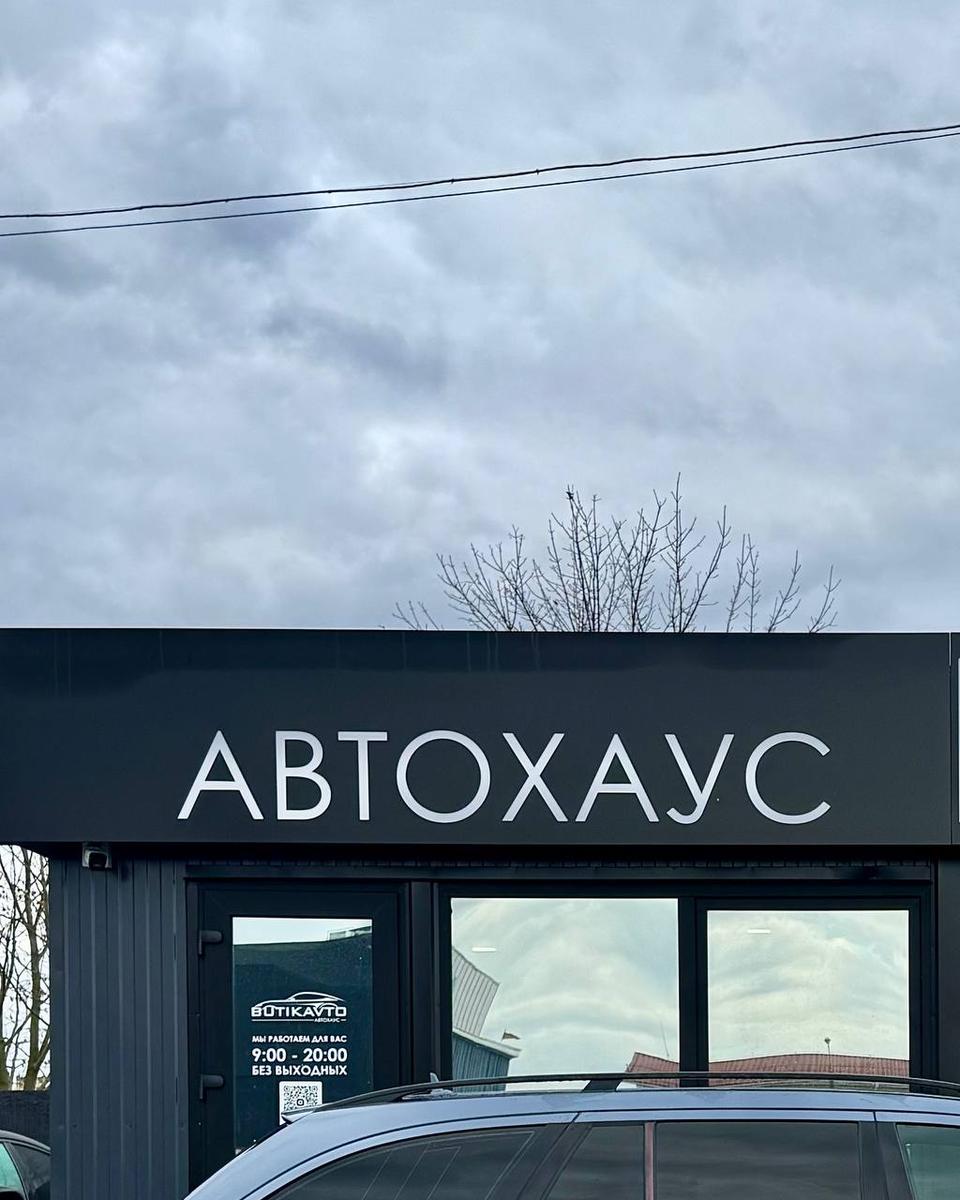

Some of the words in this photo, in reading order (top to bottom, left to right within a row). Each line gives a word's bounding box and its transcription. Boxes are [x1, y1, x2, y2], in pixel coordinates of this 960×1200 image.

[176, 730, 833, 825] АВТОХАУС
[251, 1006, 347, 1017] BUTIKAVTO
[268, 1035, 310, 1043] РАБОТАЕМ
[311, 1035, 329, 1043] ДЛЯ
[252, 1048, 287, 1062] 9:00
[303, 1048, 348, 1062] 20:00
[252, 1065, 272, 1076] БЕЗ
[275, 1065, 348, 1076] ВЫХОДНЫХ
